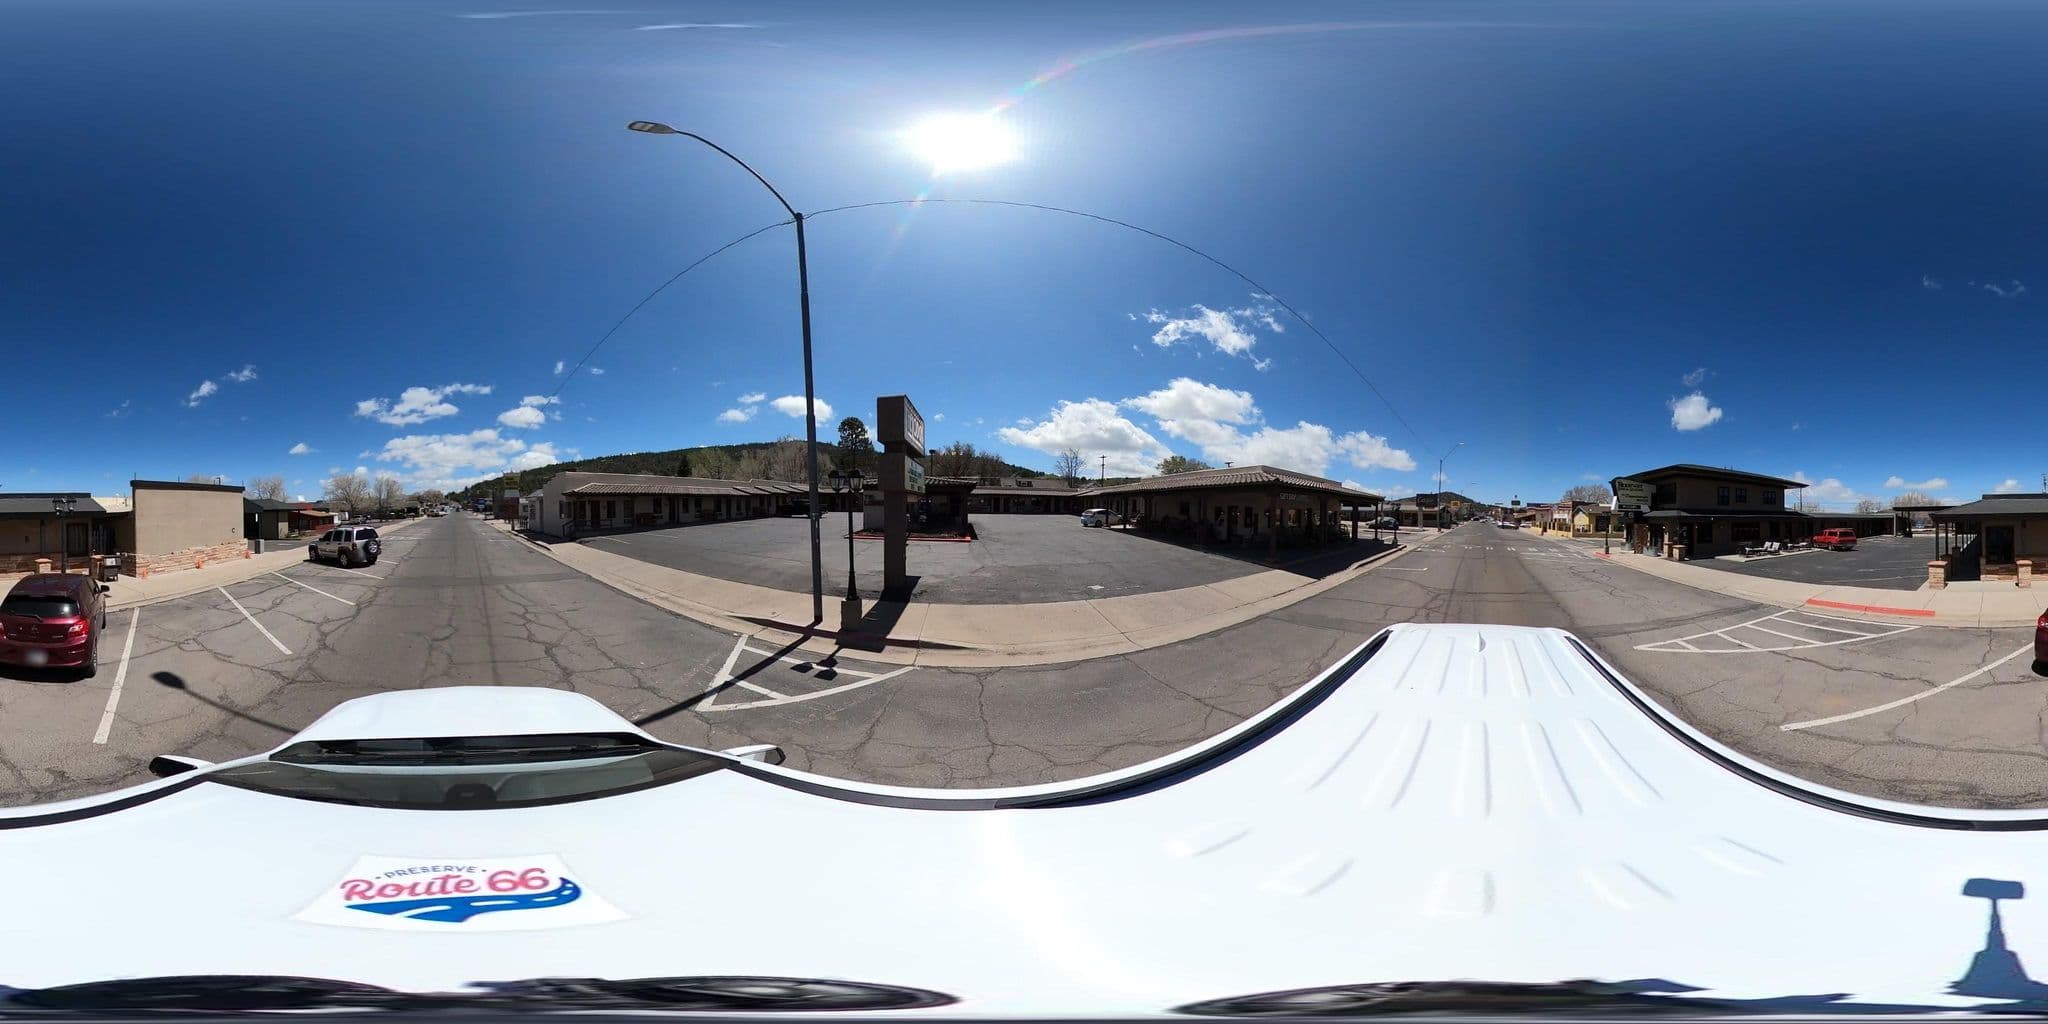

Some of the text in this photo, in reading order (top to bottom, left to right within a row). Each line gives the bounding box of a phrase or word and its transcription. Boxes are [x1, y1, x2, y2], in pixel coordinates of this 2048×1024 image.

[340, 867, 550, 901] Route 66
[384, 865, 477, 879] PRESERVE
